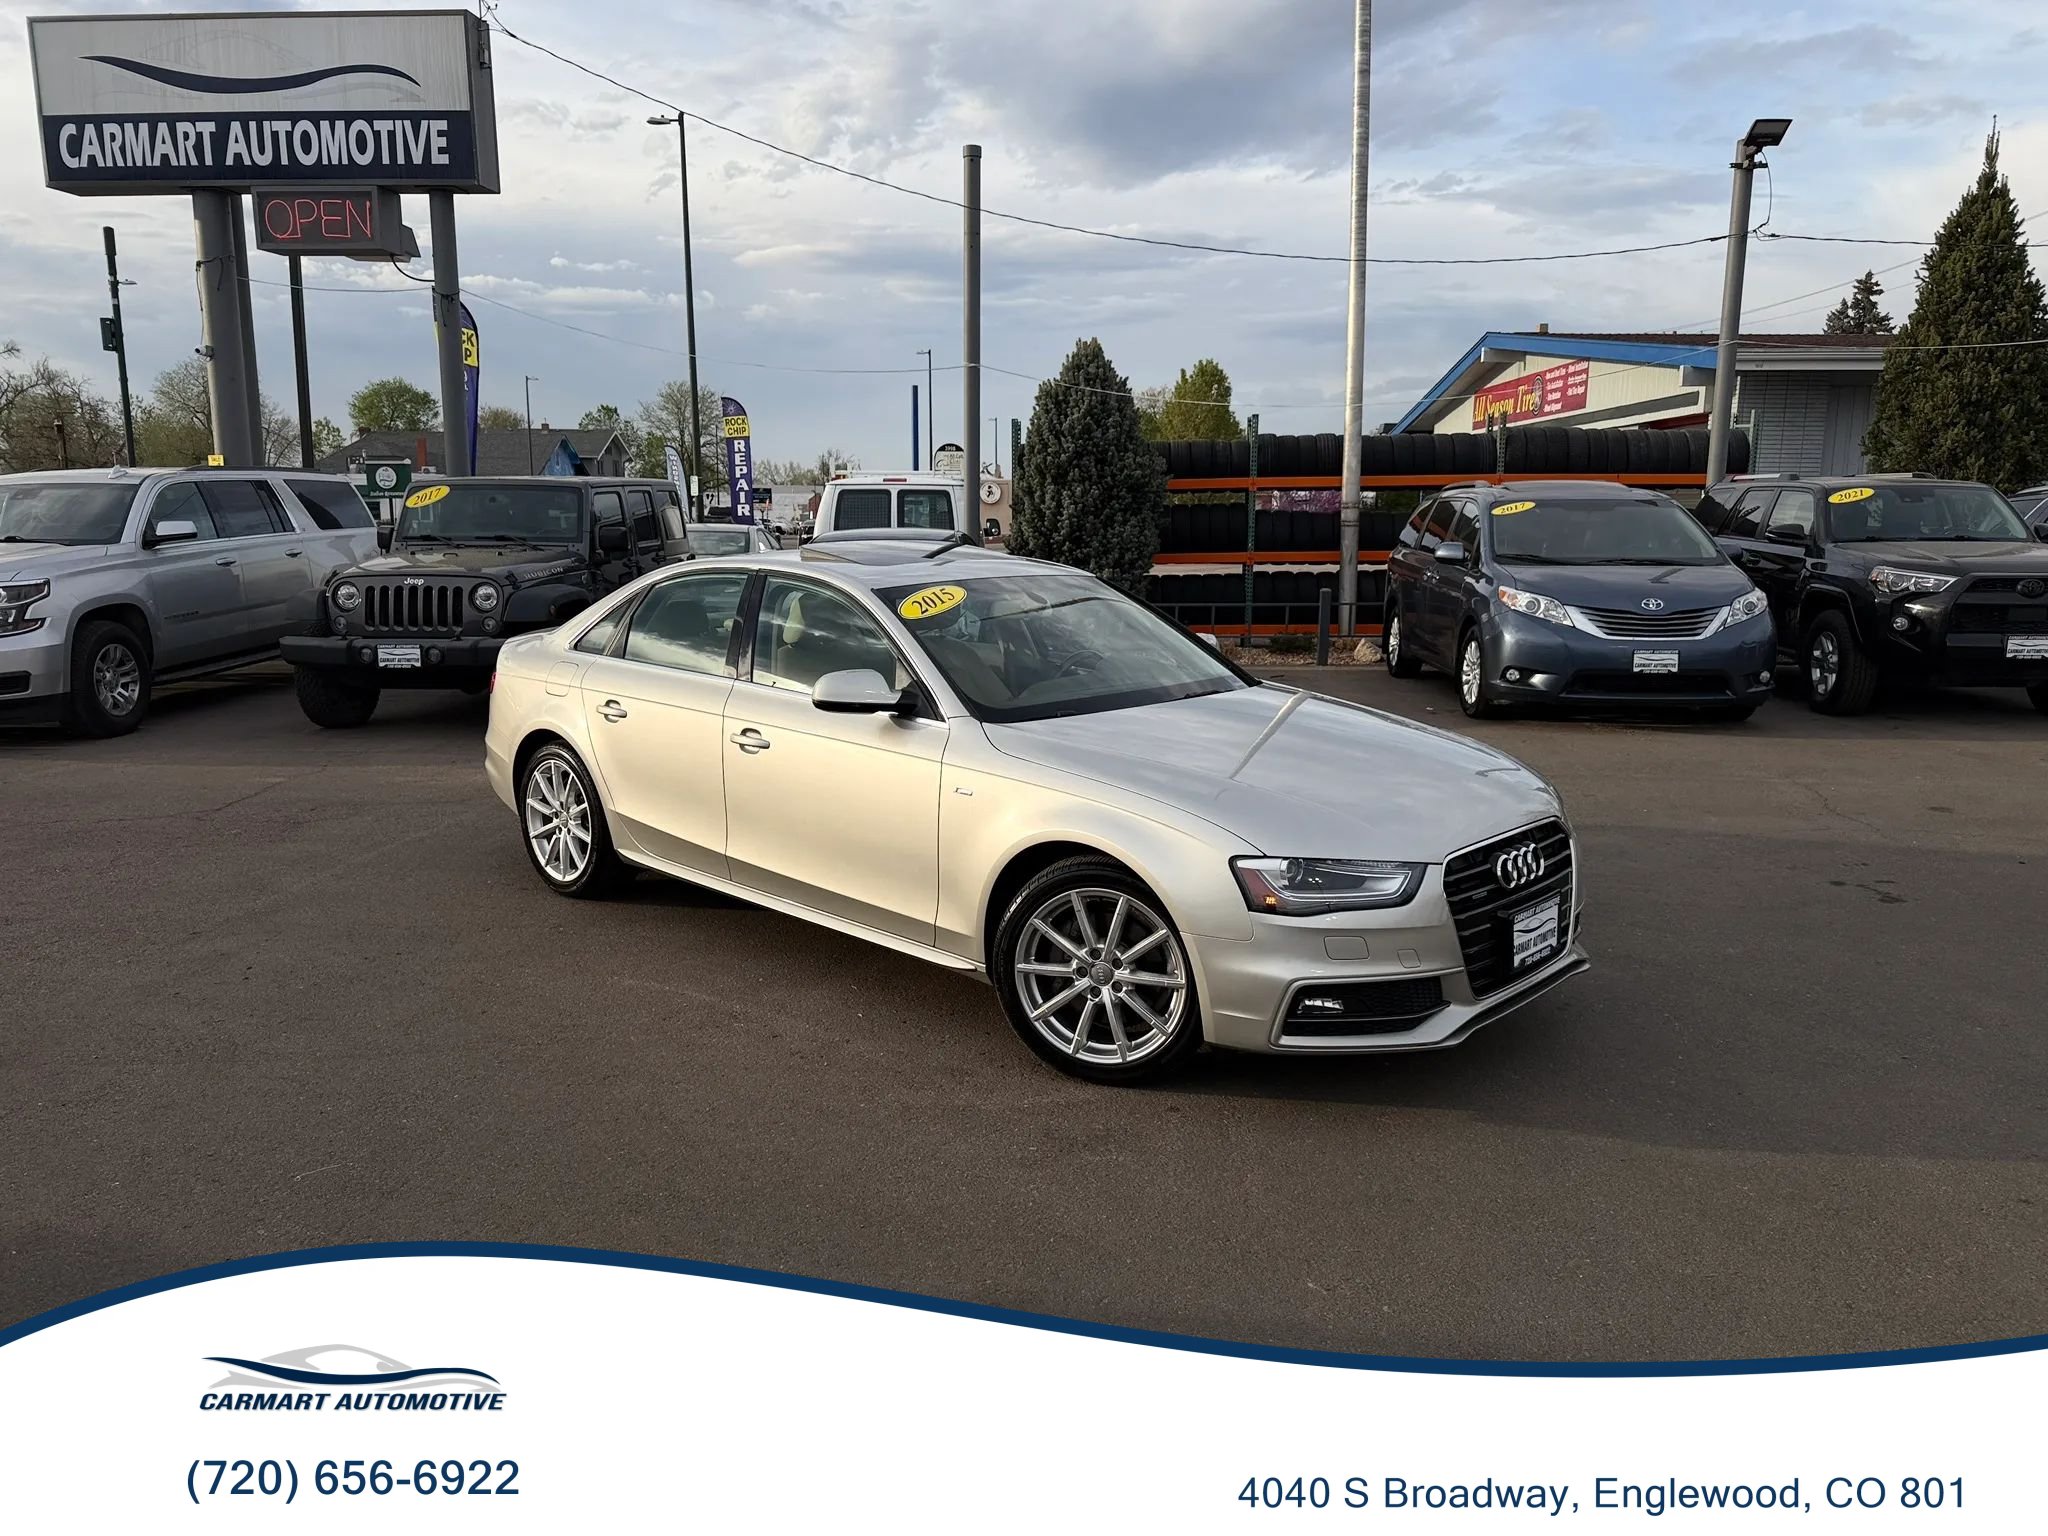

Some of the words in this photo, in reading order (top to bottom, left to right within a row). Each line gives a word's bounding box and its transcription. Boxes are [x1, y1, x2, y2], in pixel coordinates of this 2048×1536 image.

[58, 120, 216, 169] CARMART
[225, 119, 450, 167] AUTOMOTIVE
[265, 199, 371, 238] OPEN
[1474, 395, 1487, 422] All
[1487, 394, 1515, 418] Season
[725, 418, 746, 426] ROCK
[728, 426, 746, 436] CHIP
[733, 440, 751, 516] REPAIR
[413, 488, 442, 505] 2017
[1838, 490, 1864, 501] 2021
[1500, 502, 1525, 514] 2017
[404, 577, 424, 586] Jeep
[912, 588, 954, 614] 2015
[1514, 907, 1536, 923] CARMART
[1533, 926, 1556, 947] AUTOMOTIVE
